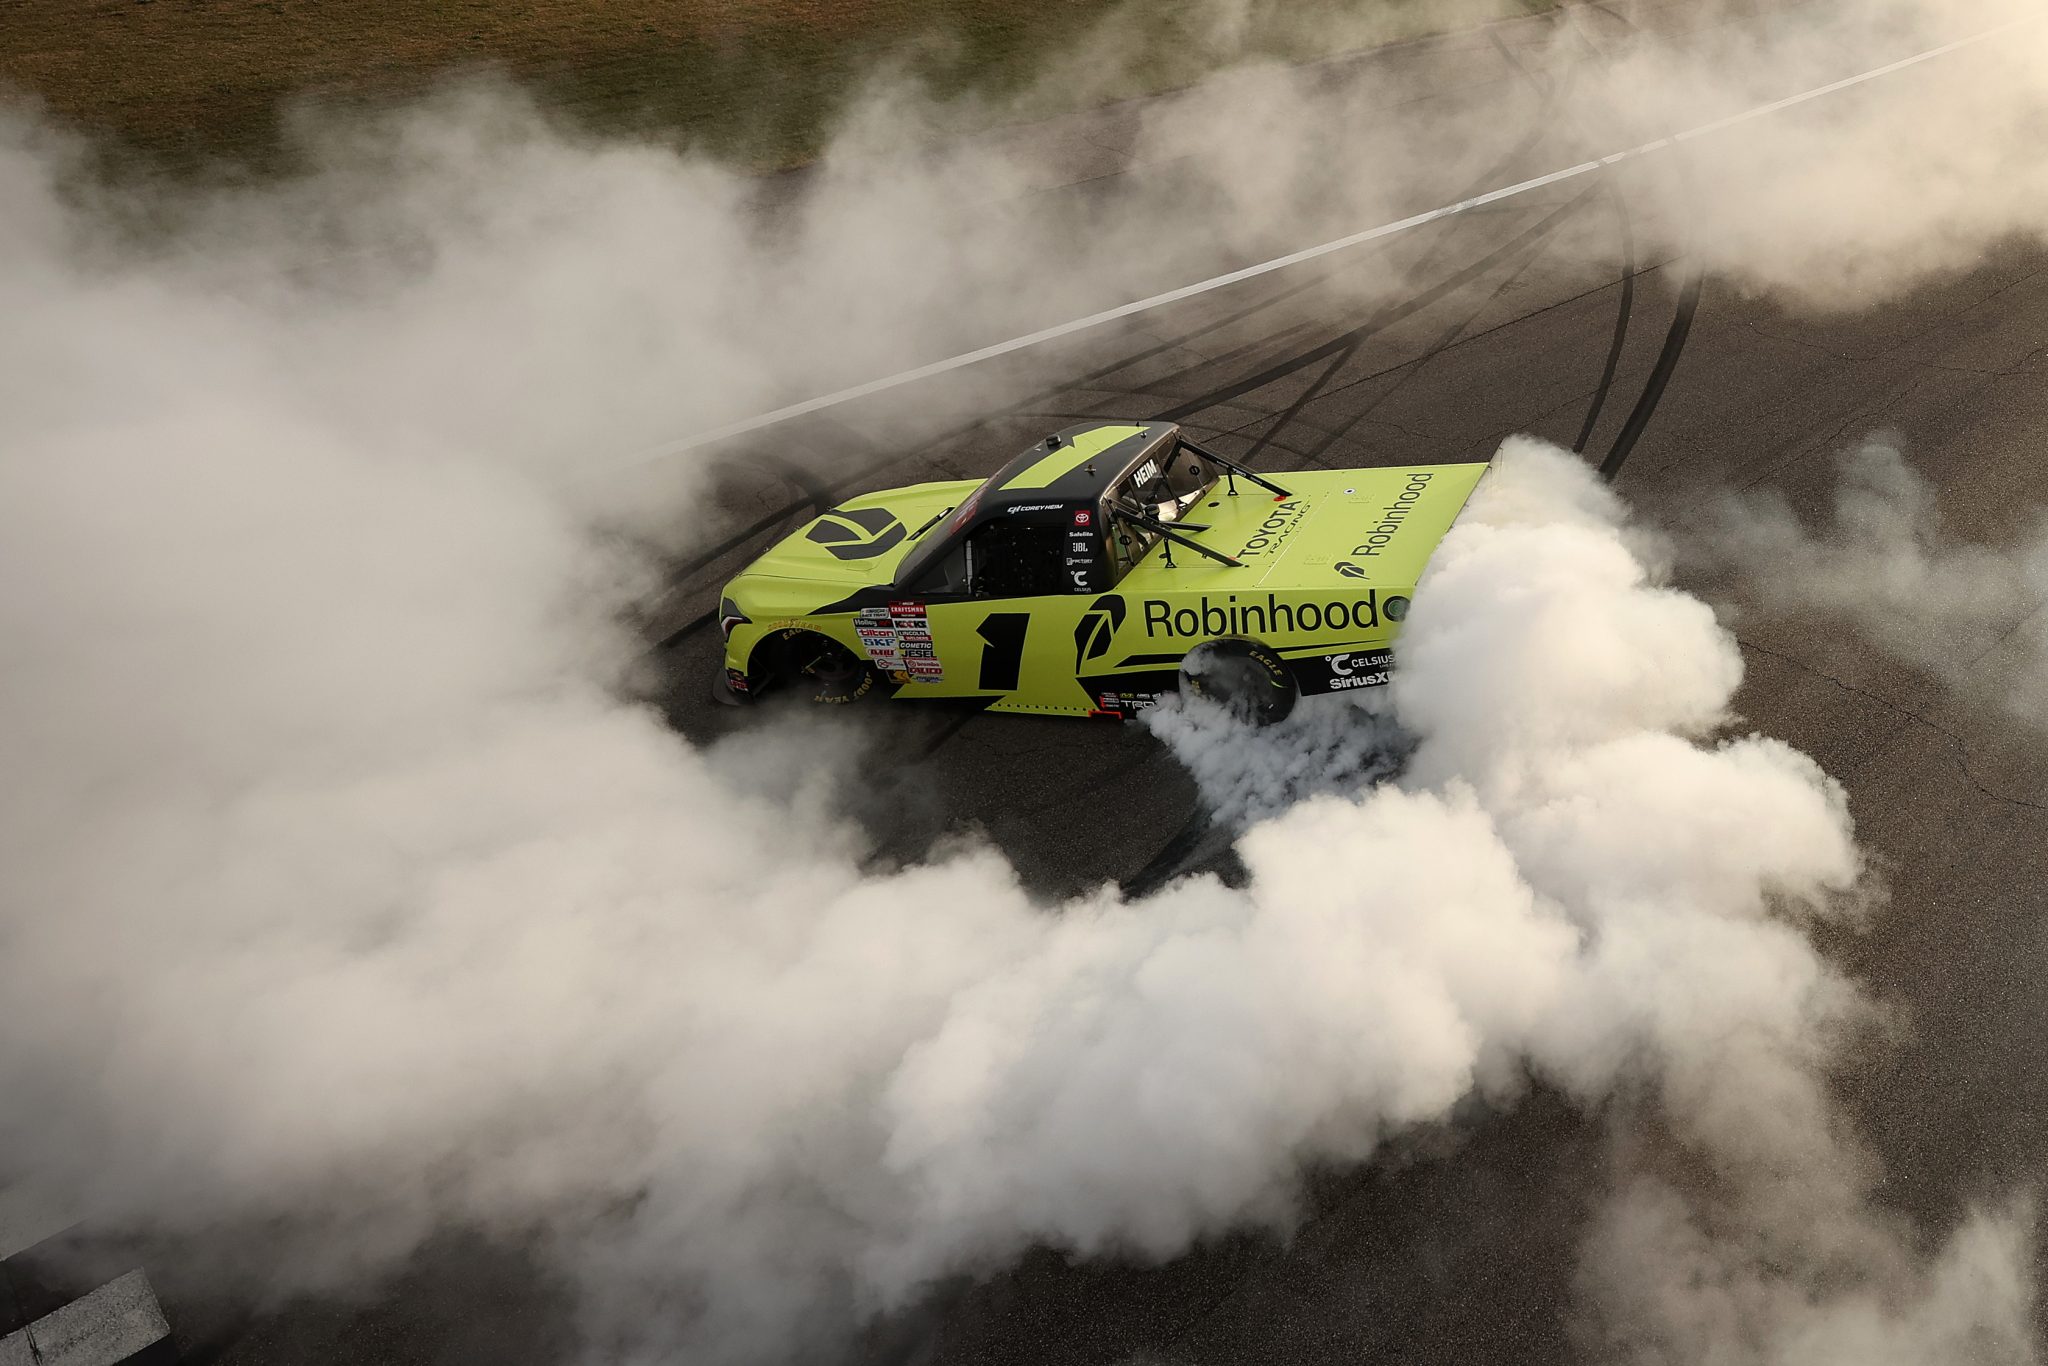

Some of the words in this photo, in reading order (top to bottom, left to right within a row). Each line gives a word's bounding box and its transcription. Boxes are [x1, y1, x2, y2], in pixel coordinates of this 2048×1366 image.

[1133, 459, 1158, 488] HEIM
[1351, 473, 1434, 556] Robinhood
[1236, 501, 1302, 558] TOYOTA
[1073, 542, 1089, 552] JBL
[855, 618, 878, 627] Holley
[1143, 589, 1379, 638] Robinhood
[901, 650, 938, 658] JESEL
[976, 613, 1031, 691] 1
[1248, 650, 1284, 676] EAGLE
[1351, 654, 1395, 668] CELSIUS
[1120, 700, 1155, 710] TRD
